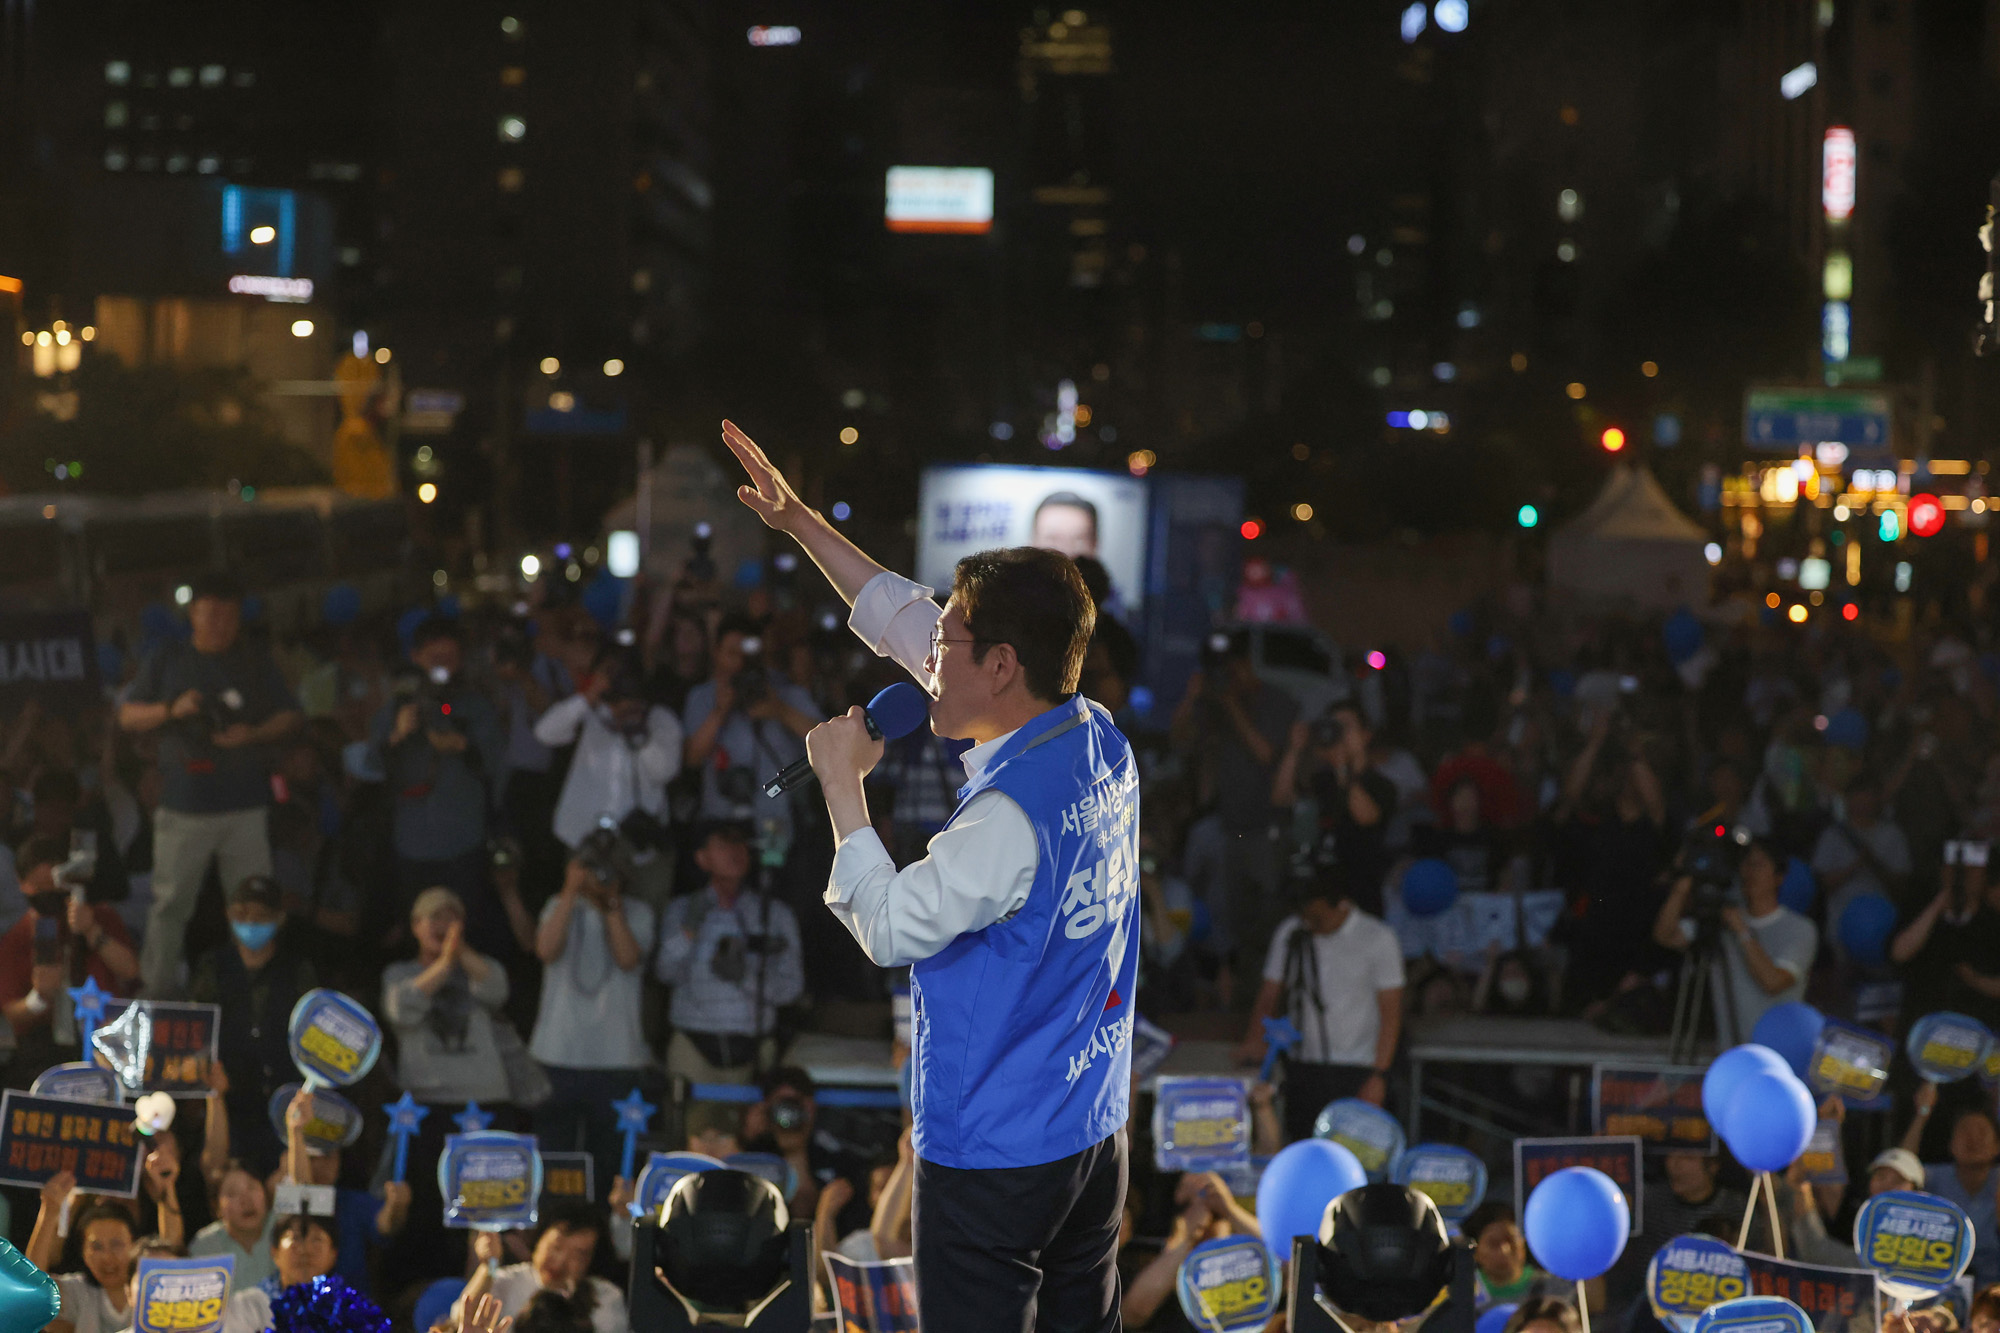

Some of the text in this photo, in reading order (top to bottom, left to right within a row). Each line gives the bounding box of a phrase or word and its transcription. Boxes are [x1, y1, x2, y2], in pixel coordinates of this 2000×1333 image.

[1873, 1233, 1953, 1270] 정원오
[1660, 1269, 1744, 1307] 정원오
[147, 1297, 222, 1329] 정원오
